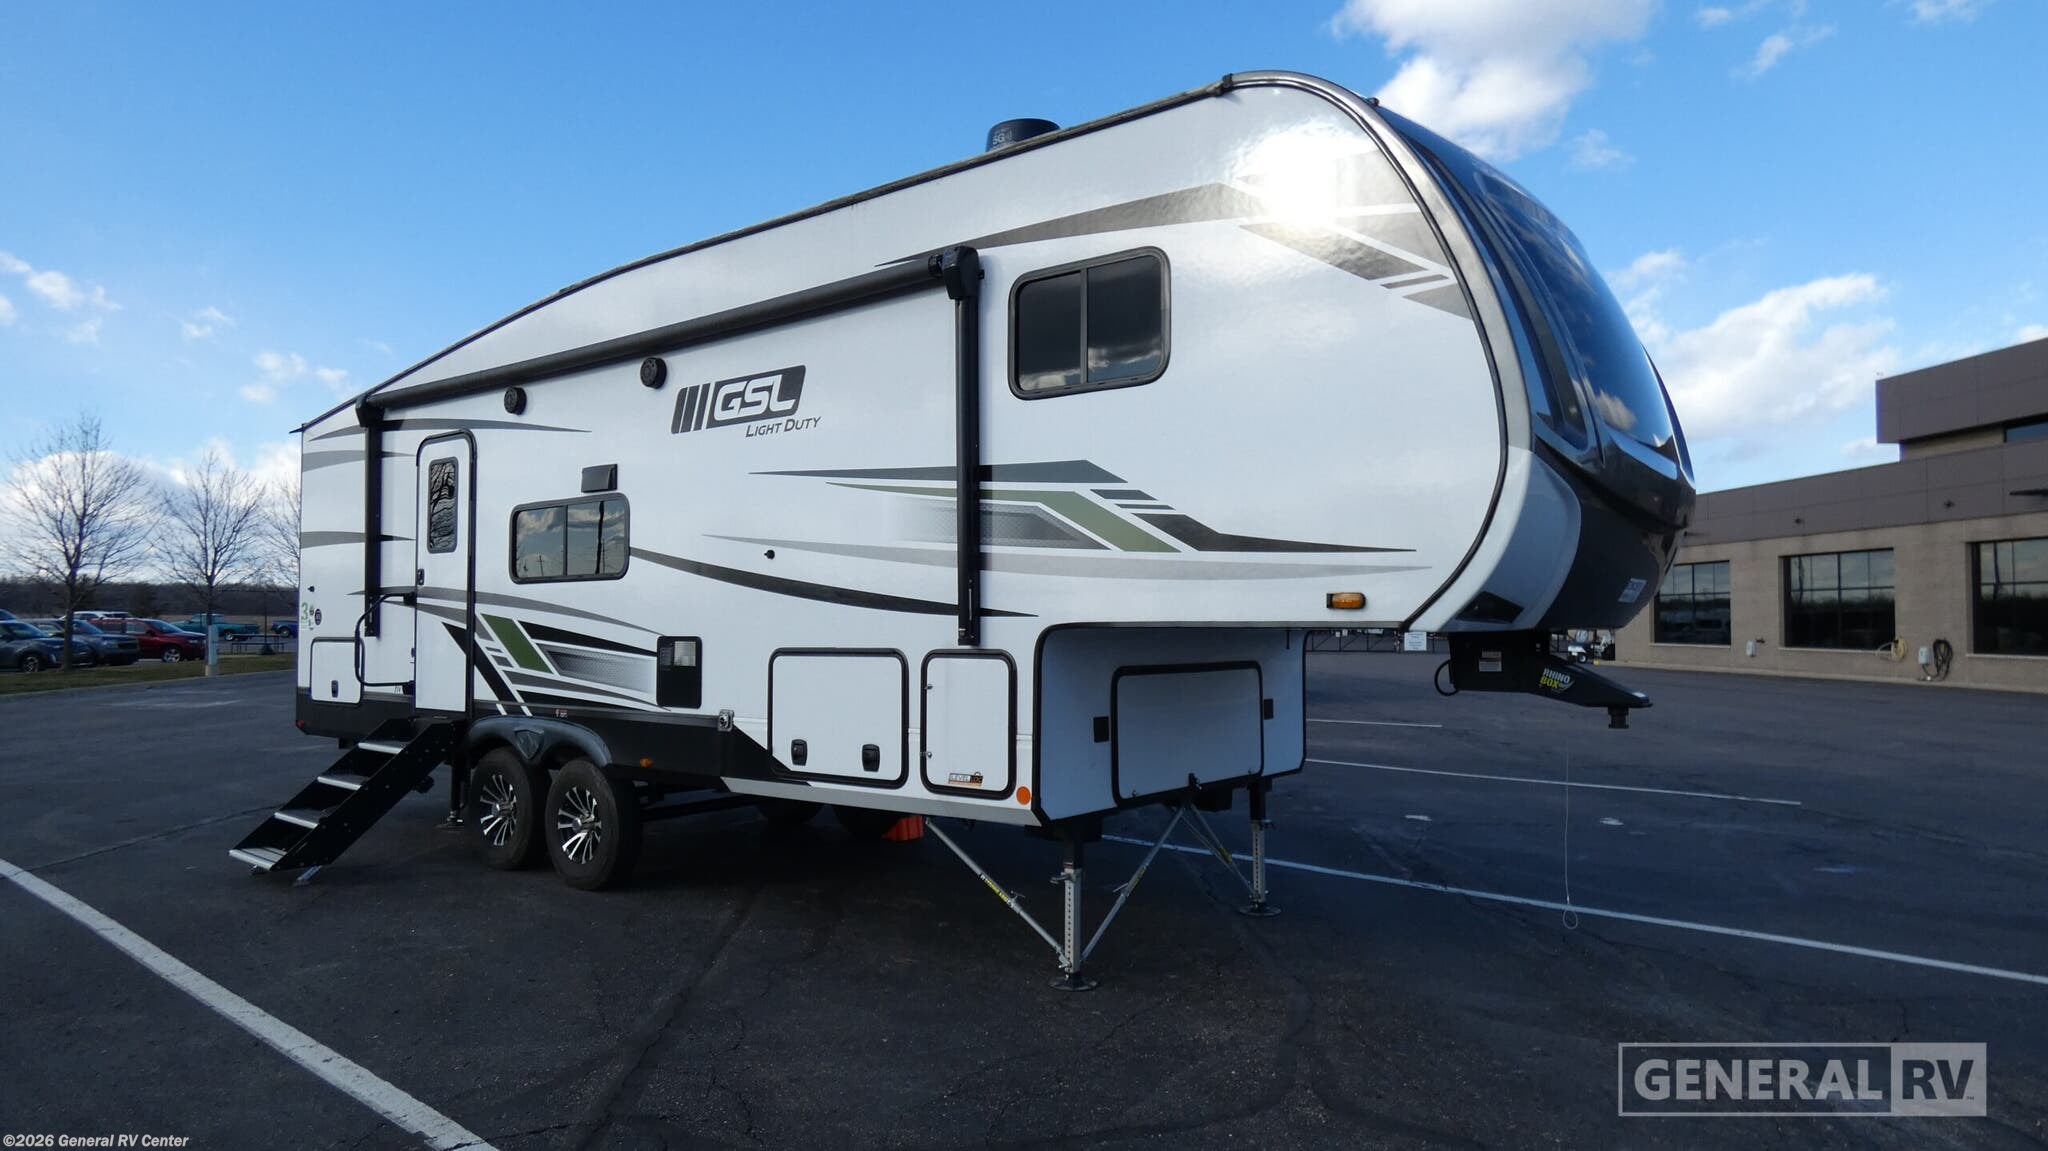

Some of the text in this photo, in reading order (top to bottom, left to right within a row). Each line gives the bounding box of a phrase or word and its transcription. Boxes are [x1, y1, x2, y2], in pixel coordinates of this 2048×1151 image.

[714, 375, 796, 421] GSL
[745, 417, 821, 438] LIGHT DUTY
[1540, 676, 1560, 689] BOX
[1543, 668, 1571, 684] RHINO
